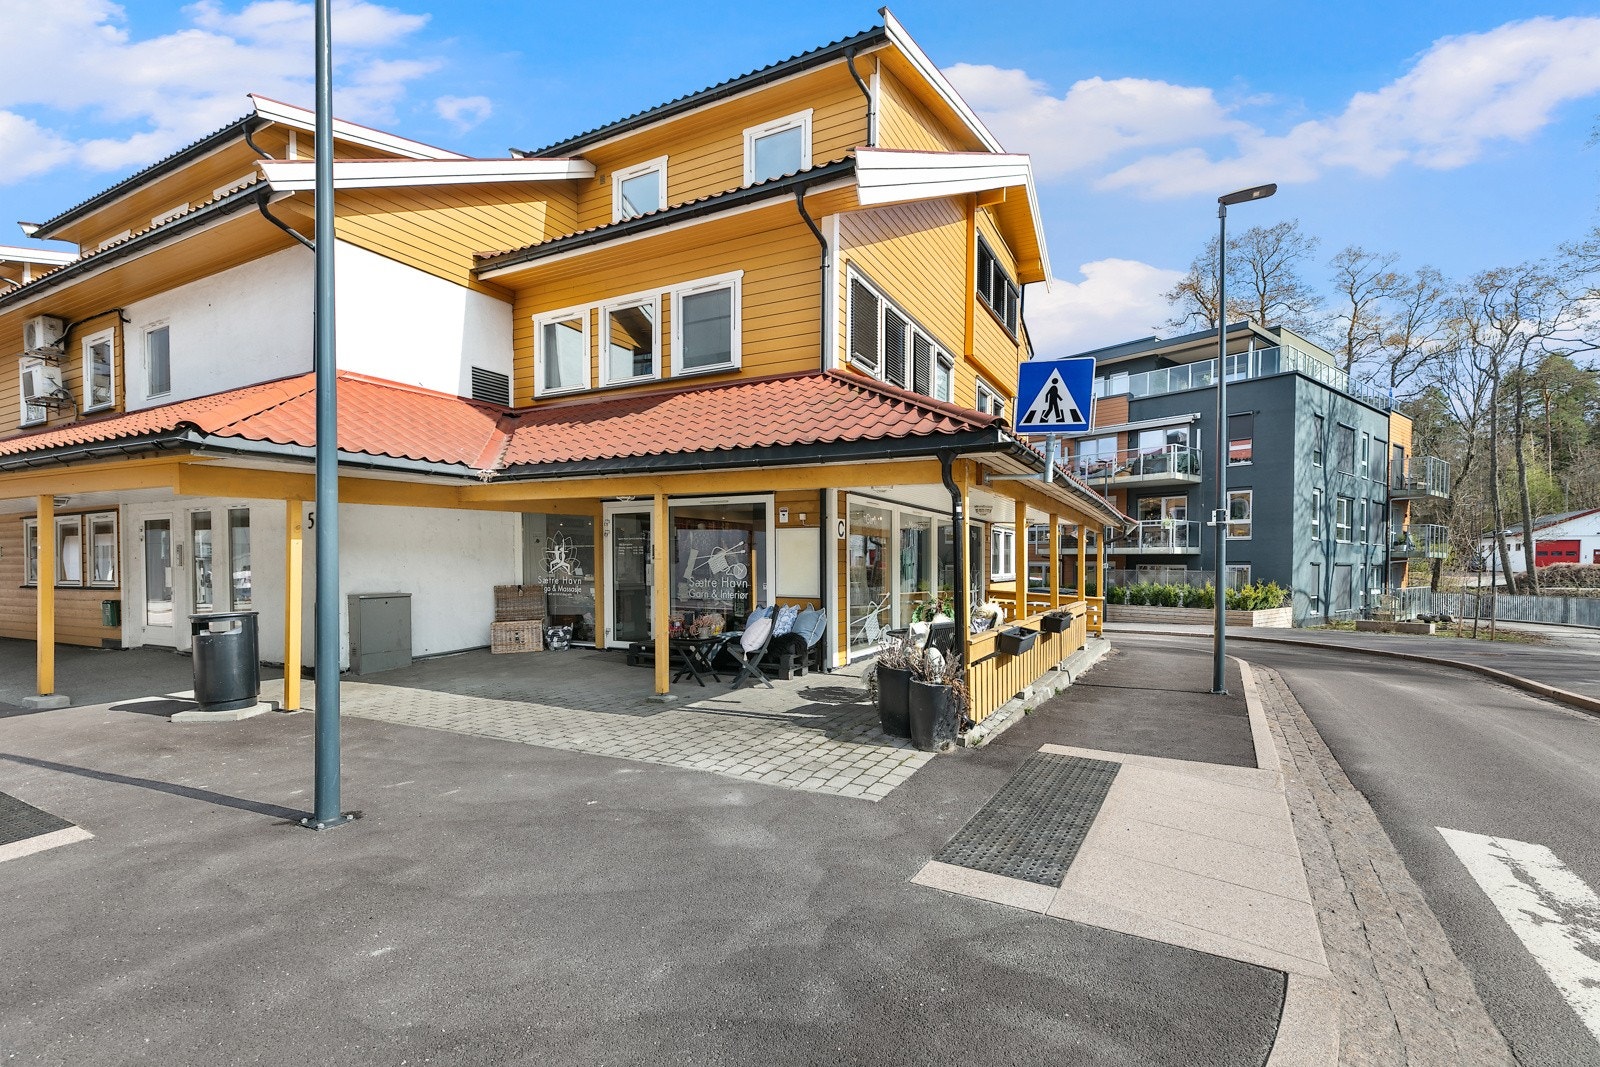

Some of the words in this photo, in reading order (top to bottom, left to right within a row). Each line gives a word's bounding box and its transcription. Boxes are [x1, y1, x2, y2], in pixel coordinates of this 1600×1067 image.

[308, 511, 315, 529] 5
[837, 520, 845, 537] C
[537, 575, 559, 585] Sætre
[562, 576, 582, 585] Havn
[689, 576, 718, 588] Sætre
[721, 576, 748, 588] Havn
[557, 585, 582, 595] Massasje
[688, 588, 709, 598] Garn
[711, 588, 718, 599] &
[720, 589, 749, 600] Interiør
